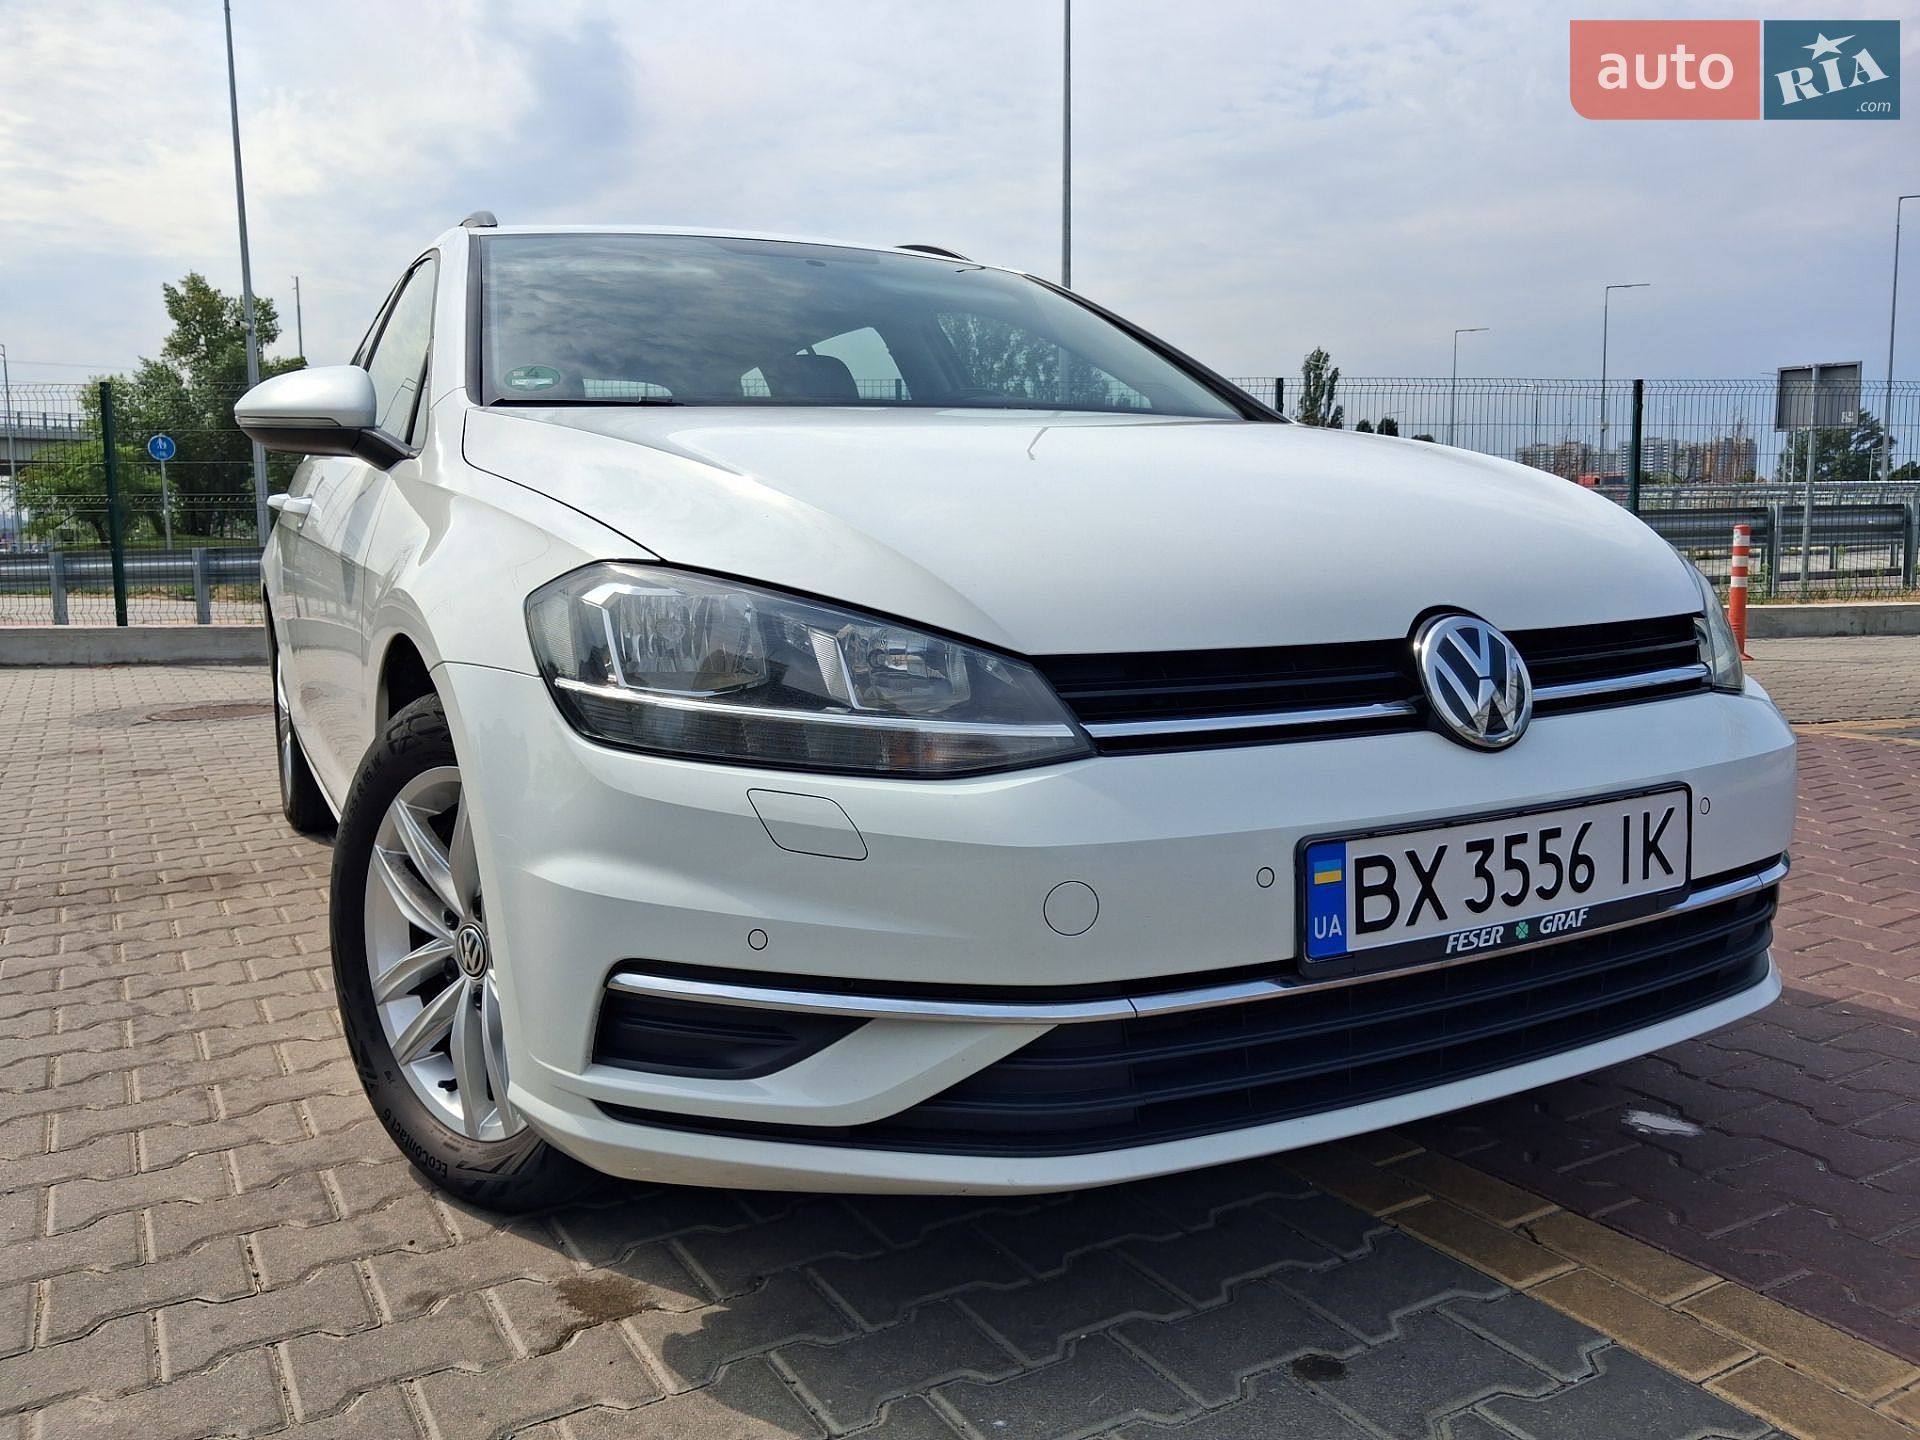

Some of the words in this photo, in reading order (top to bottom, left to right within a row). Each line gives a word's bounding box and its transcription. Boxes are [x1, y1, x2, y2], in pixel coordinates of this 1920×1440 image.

[1354, 844, 1448, 936] BX
[1464, 821, 1595, 914] 3556
[1622, 807, 1675, 885] IK
[1313, 913, 1344, 940] UA
[1445, 925, 1505, 955] FESER
[1538, 907, 1590, 935] GRAF
[389, 1116, 448, 1178] EcoContact
